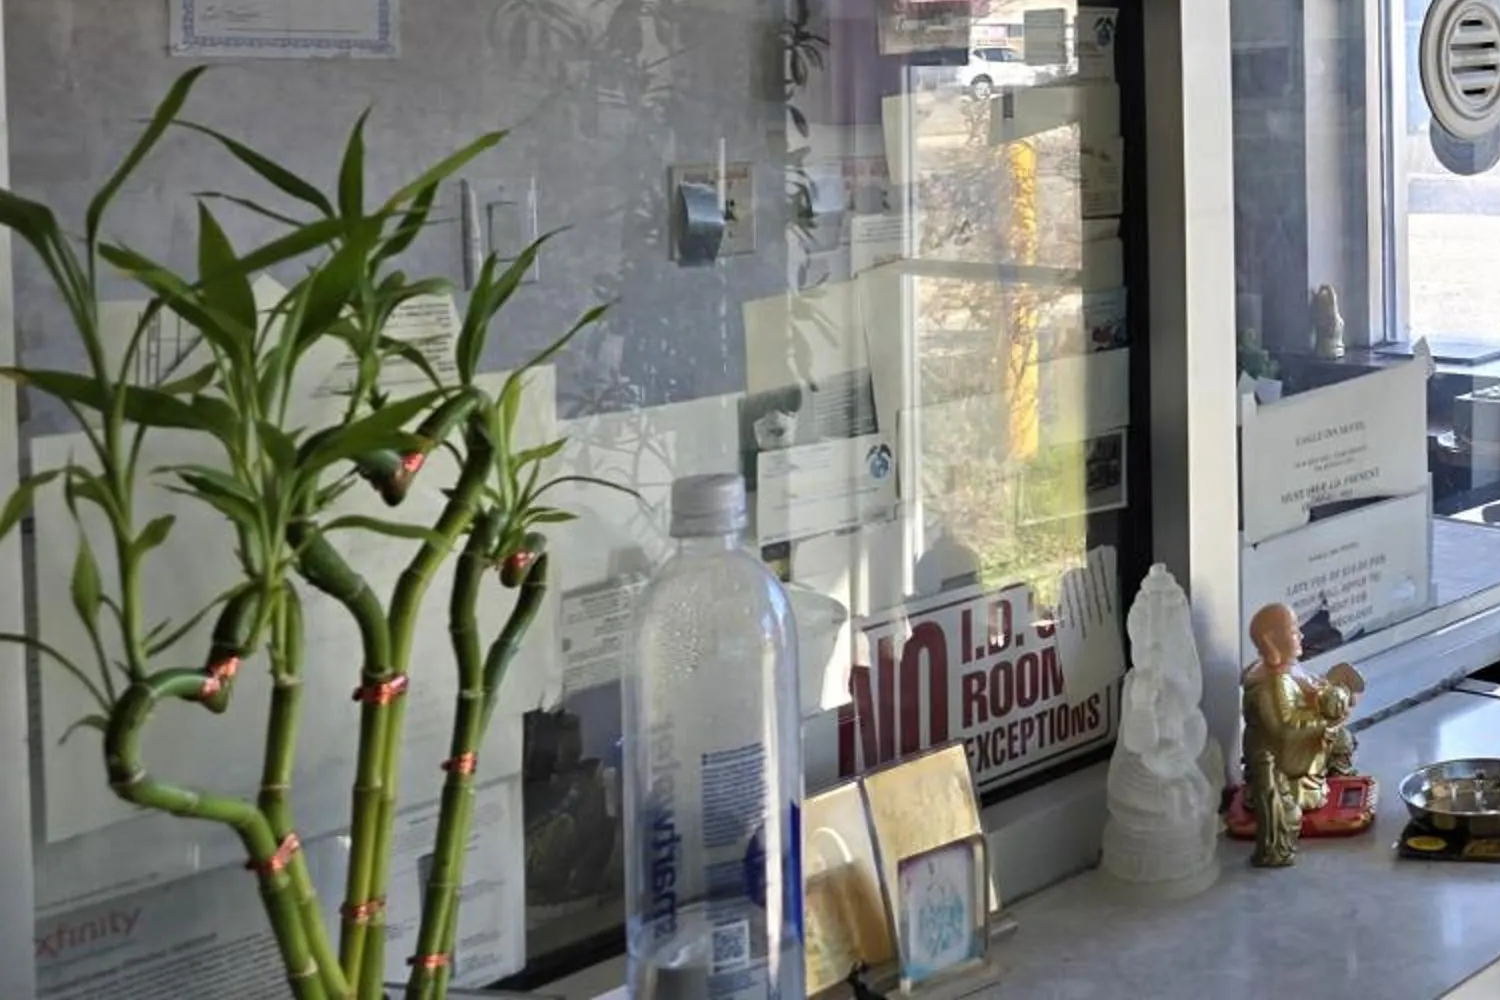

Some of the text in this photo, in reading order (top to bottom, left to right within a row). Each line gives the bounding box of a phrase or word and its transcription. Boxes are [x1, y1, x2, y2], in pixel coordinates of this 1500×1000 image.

[961, 599, 1025, 665] I.D.
[838, 620, 949, 778] NO
[35, 907, 142, 959] xfinity
